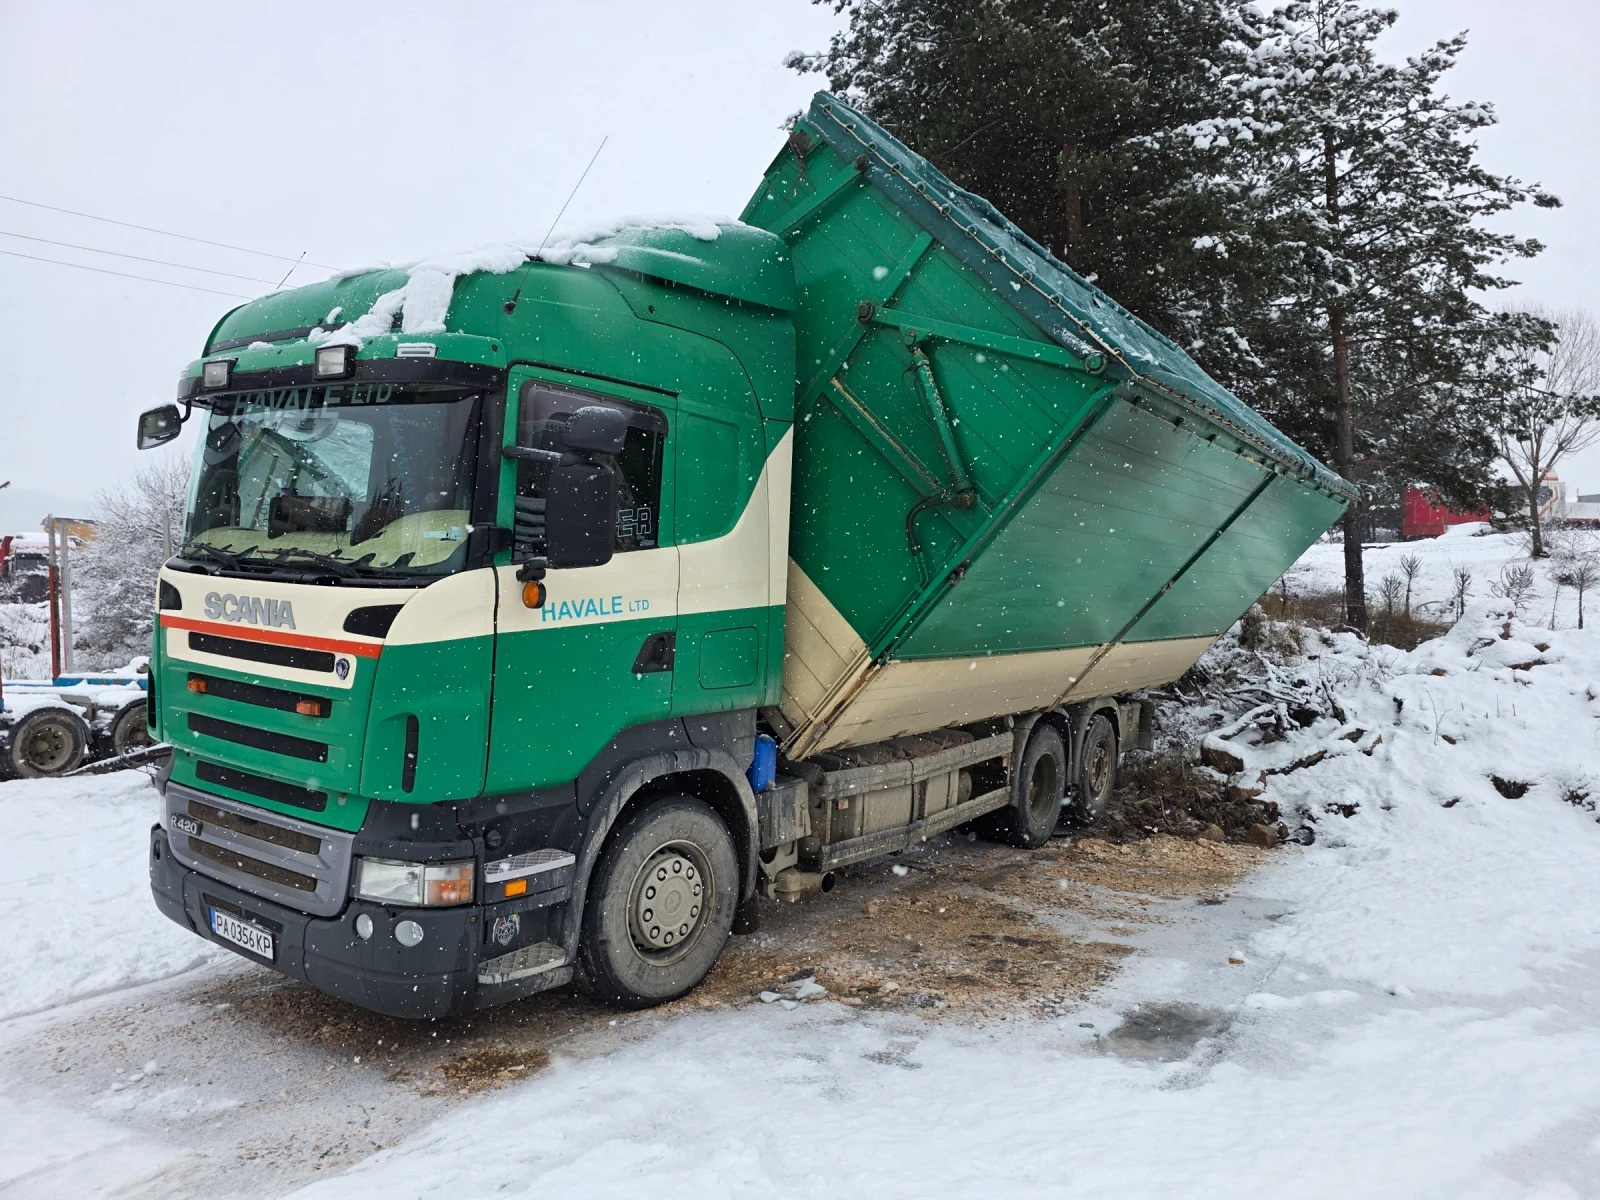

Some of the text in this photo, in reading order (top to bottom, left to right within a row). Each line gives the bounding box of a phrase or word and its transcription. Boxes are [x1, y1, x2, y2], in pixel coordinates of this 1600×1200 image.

[231, 383, 393, 421] HAVALE LTD
[615, 507, 652, 538] ER
[204, 592, 296, 630] SCANIA
[541, 595, 650, 622] HAVALE LTD
[171, 815, 197, 834] R420
